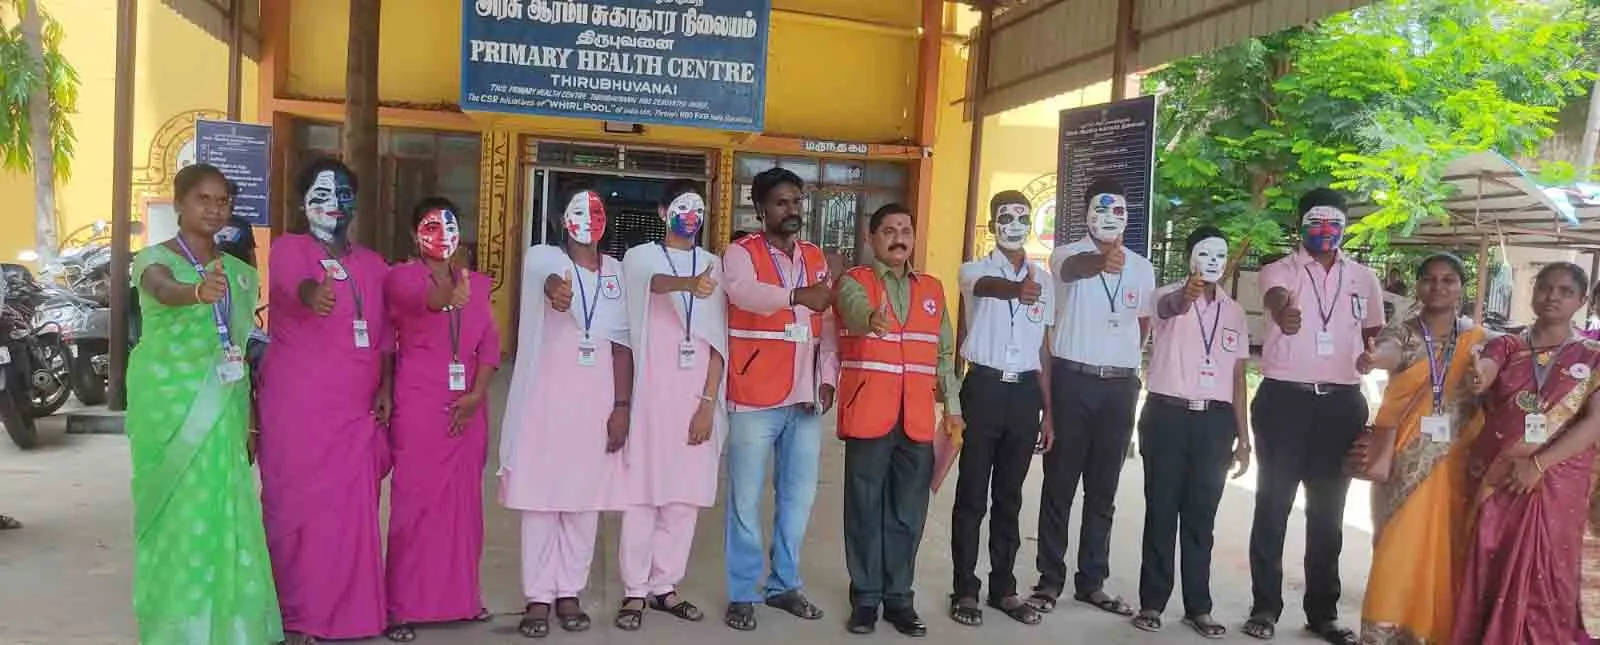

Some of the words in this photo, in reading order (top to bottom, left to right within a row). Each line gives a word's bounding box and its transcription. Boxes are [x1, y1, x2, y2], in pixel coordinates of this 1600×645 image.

[591, 4, 678, 36] சுகாதார
[681, 7, 758, 39] நிலையம்
[575, 29, 676, 50] திருபுவனை
[470, 39, 575, 69] PRIMARY
[576, 48, 665, 77] HEALTH
[667, 57, 755, 83] CENTRE
[550, 74, 679, 96] THIRUBHUVANAI
[480, 94, 499, 104] CSR
